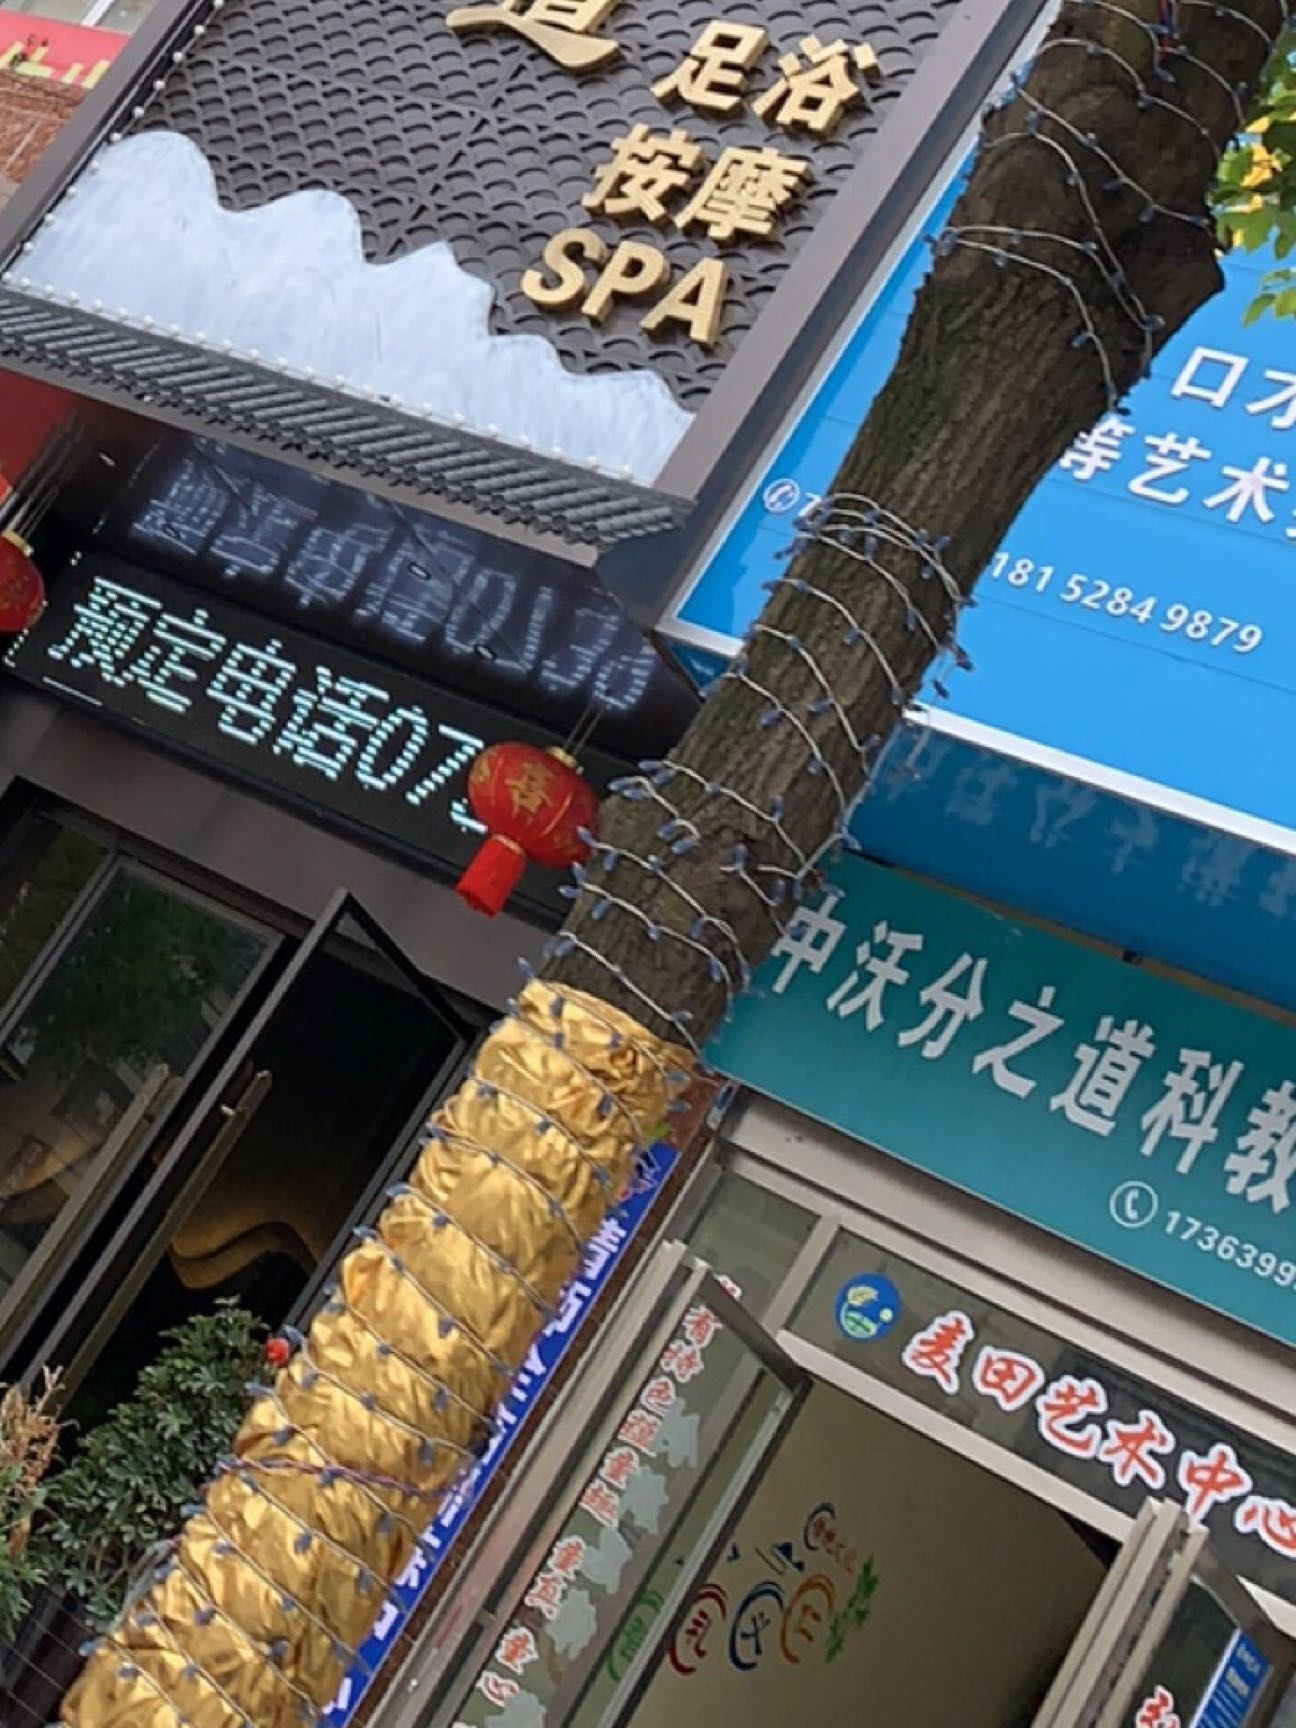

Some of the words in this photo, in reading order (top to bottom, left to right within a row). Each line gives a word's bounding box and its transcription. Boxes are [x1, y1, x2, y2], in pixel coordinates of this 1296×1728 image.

[651, 19, 882, 134] 足浴
[582, 122, 813, 242] 按摩
[520, 227, 730, 346] SPA
[1059, 418, 1296, 537] 等艺术
[990, 550, 1054, 593] 181
[1058, 573, 1157, 624] 5284
[1159, 603, 1262, 653] 9879
[48, 575, 486, 834] 预定电话07
[771, 890, 1296, 1214] 中沃分之道科教
[1165, 1210, 1296, 1289] 1736399
[904, 1312, 1296, 1557] 麦田艺术中心
